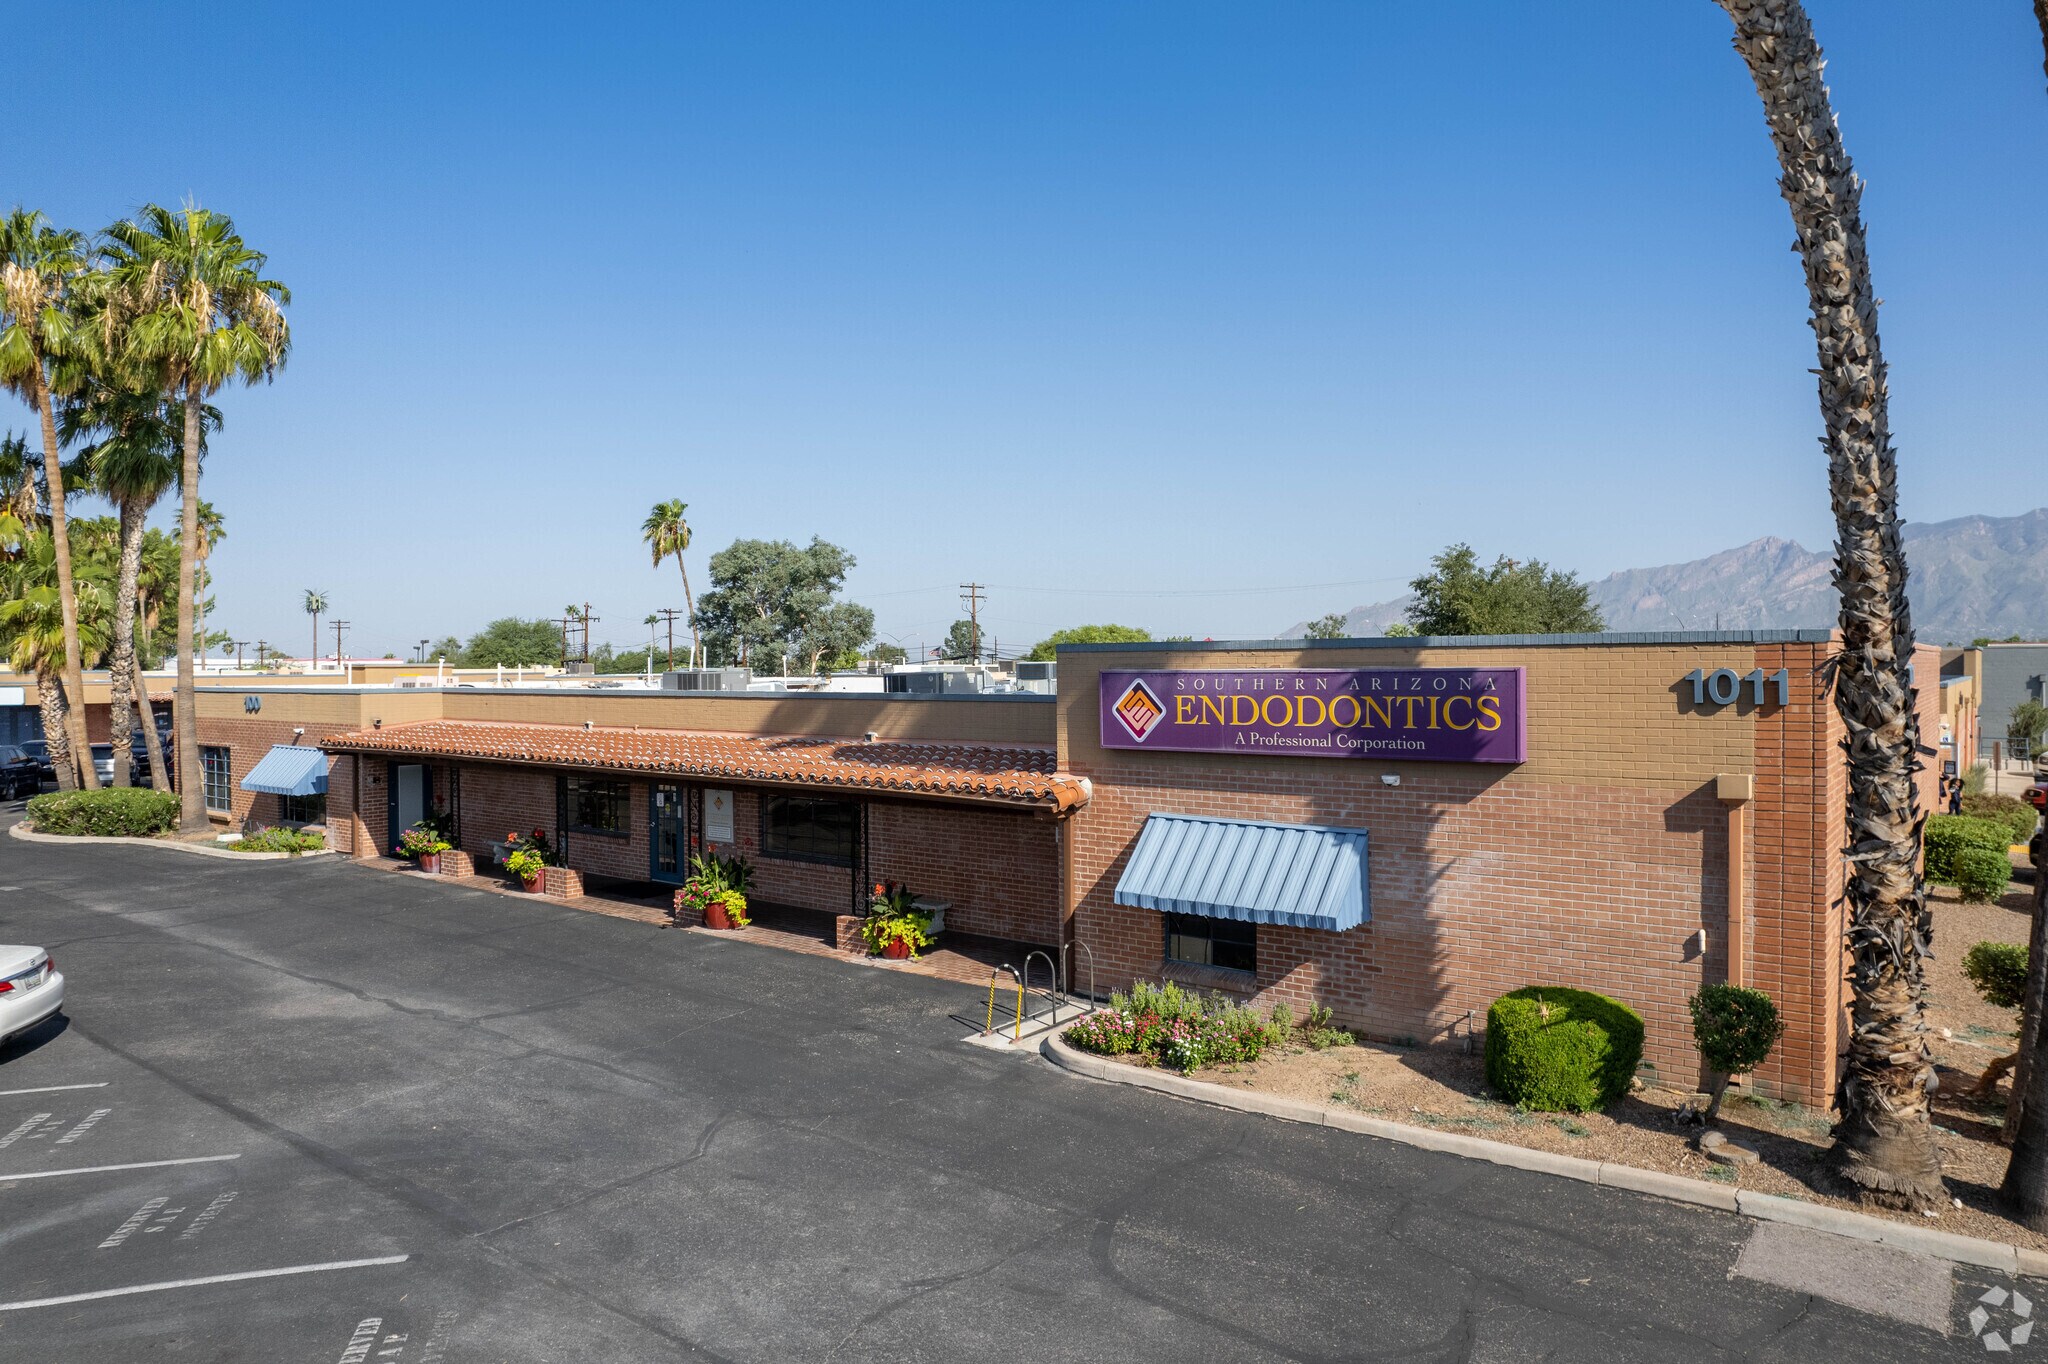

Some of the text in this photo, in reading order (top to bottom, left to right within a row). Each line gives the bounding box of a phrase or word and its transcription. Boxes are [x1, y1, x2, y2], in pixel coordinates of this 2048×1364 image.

[1177, 677, 1497, 691] SOUTHERN ARIZONA
[1685, 667, 1789, 706] 1011
[1174, 694, 1502, 731] ENDODONTICS
[1235, 732, 1425, 752] A Professional Corporation
[96, 1196, 170, 1248] RESERVED
